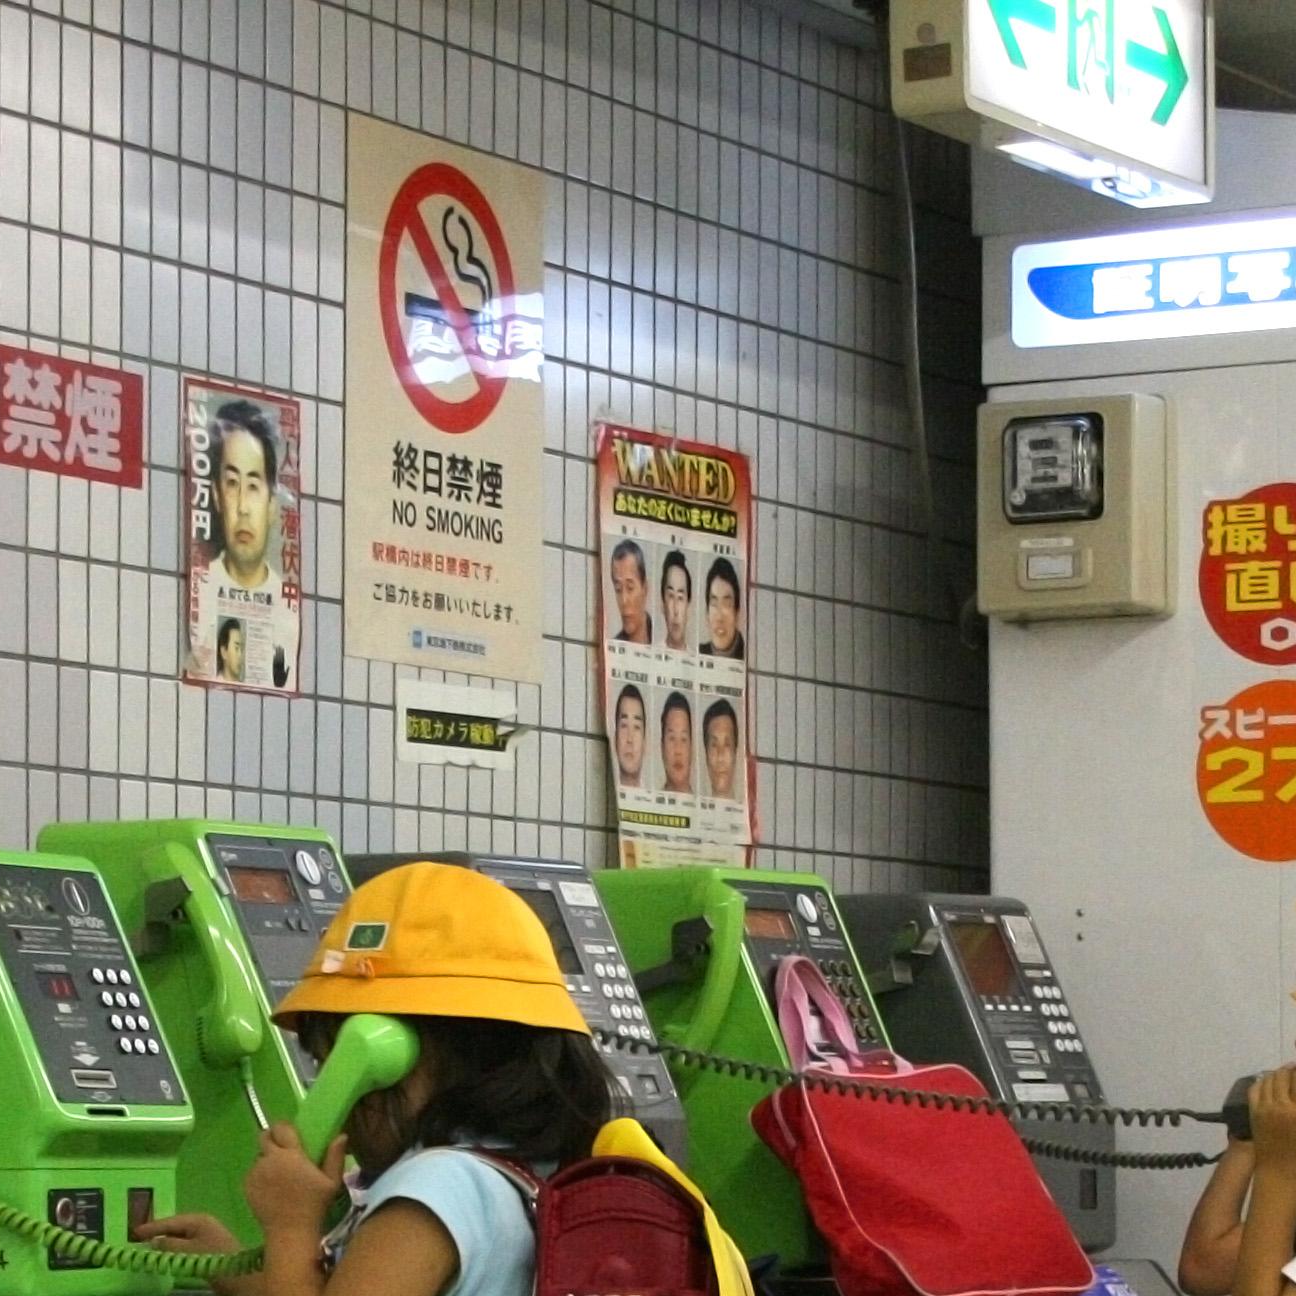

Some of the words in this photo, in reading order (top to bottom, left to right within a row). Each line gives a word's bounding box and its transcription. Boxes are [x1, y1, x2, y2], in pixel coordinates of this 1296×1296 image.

[391, 440, 504, 510] 終日禁煙
[612, 437, 737, 506] WANTED
[392, 498, 417, 528] NO
[426, 505, 504, 545] SMOKING
